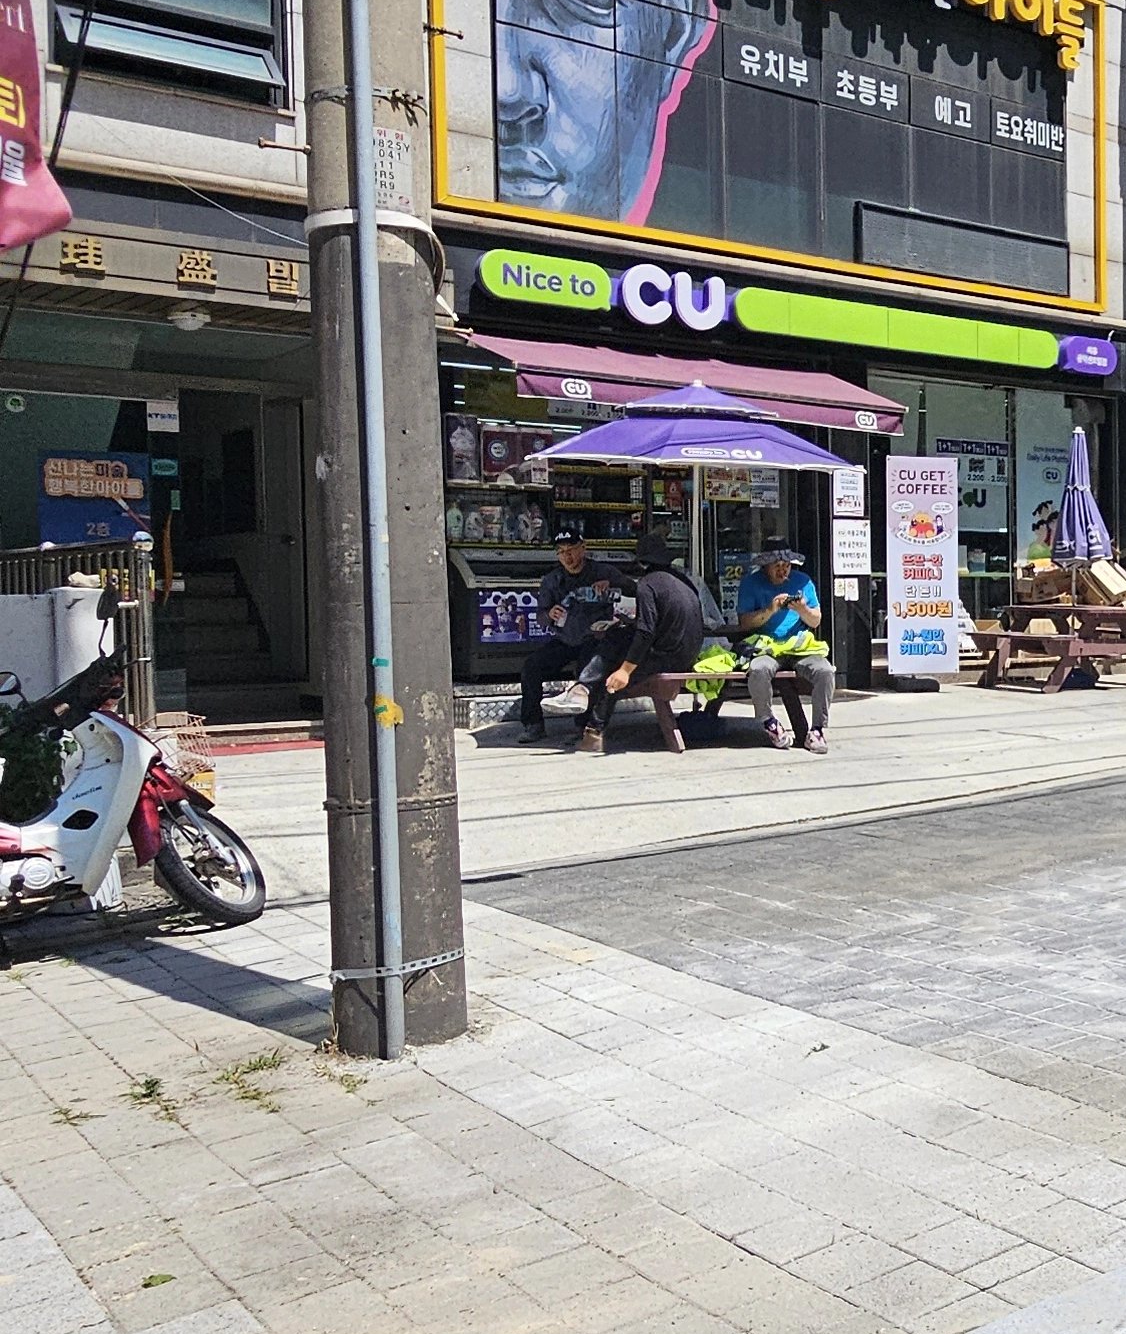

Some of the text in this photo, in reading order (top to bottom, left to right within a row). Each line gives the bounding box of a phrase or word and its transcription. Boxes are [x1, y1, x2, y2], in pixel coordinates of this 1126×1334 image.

[740, 44, 809, 87] 유치부
[836, 70, 898, 111] 초등부
[935, 95, 972, 128] 예고
[996, 111, 1065, 152] 토요취미반
[379, 149, 401, 161] 041
[502, 263, 726, 331] Nice to CU
[731, 449, 762, 460] CU
[899, 470, 946, 481] CU GET
[1045, 471, 1058, 480] CU
[898, 484, 947, 495] COFFEE
[893, 601, 953, 619] 1,500원
